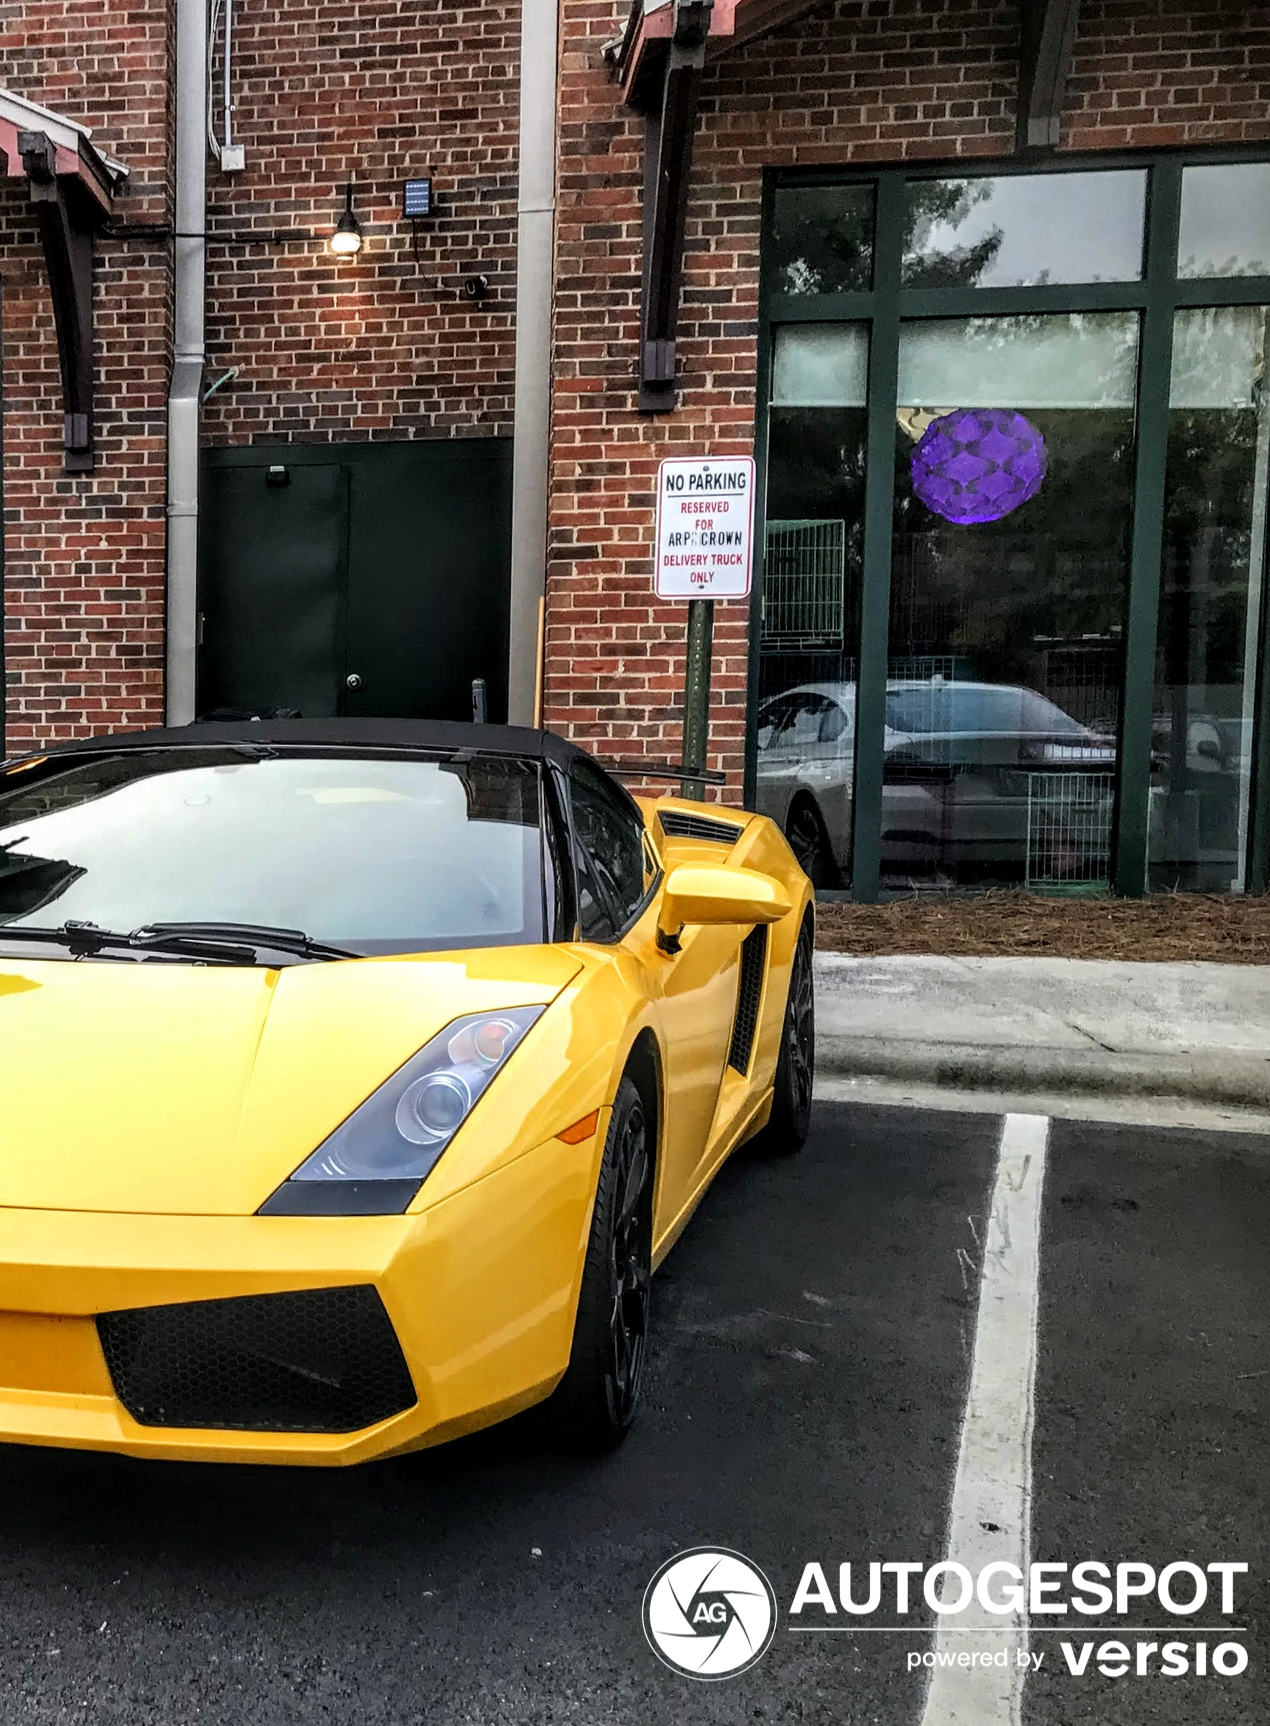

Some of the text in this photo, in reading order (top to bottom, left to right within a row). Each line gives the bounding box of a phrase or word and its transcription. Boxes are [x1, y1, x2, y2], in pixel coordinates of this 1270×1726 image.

[666, 472, 746, 491] NO PARKING
[681, 501, 729, 514] RESERVED
[695, 519, 713, 530] FOR
[701, 531, 742, 546] CROWN
[663, 554, 743, 567] DELIVERY TRUCK
[690, 571, 715, 583] ONLY
